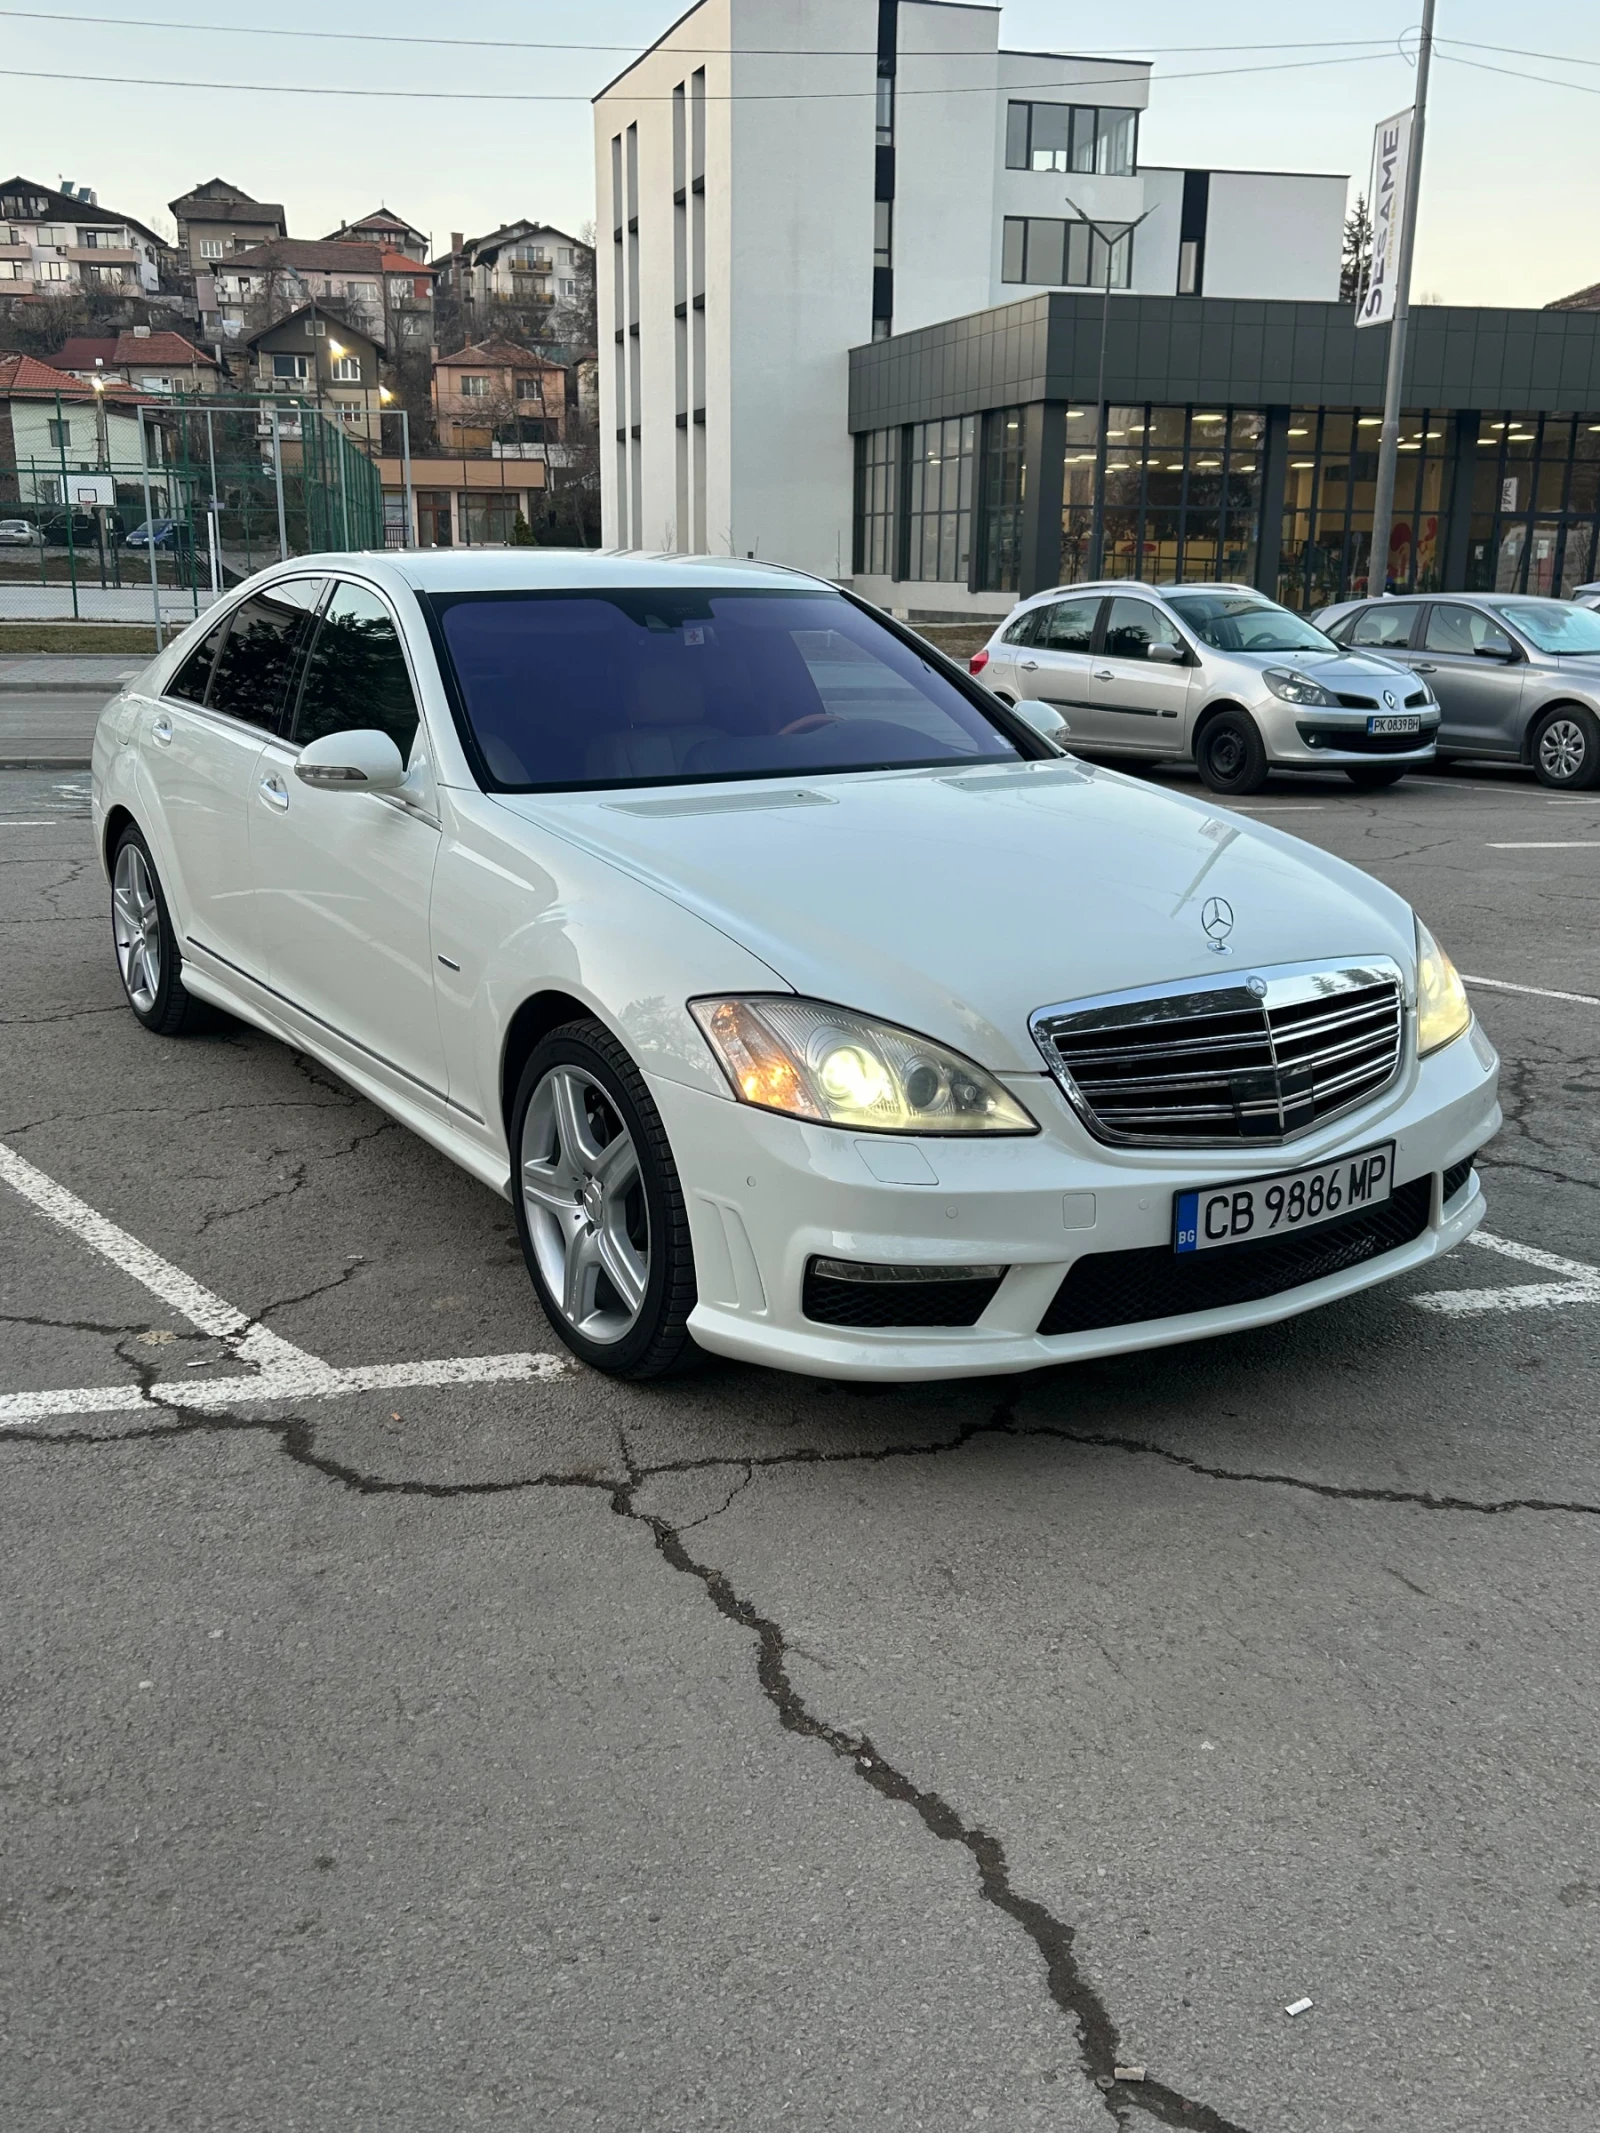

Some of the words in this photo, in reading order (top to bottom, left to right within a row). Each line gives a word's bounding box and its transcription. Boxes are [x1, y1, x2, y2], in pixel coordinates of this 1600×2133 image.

[1365, 126, 1399, 318] SESAME
[1387, 719, 1407, 731] 0839
[1205, 1190, 1254, 1240] CB
[1265, 1168, 1342, 1229] 9886
[1348, 1154, 1386, 1205] MP
[1178, 1229, 1195, 1245] BG
